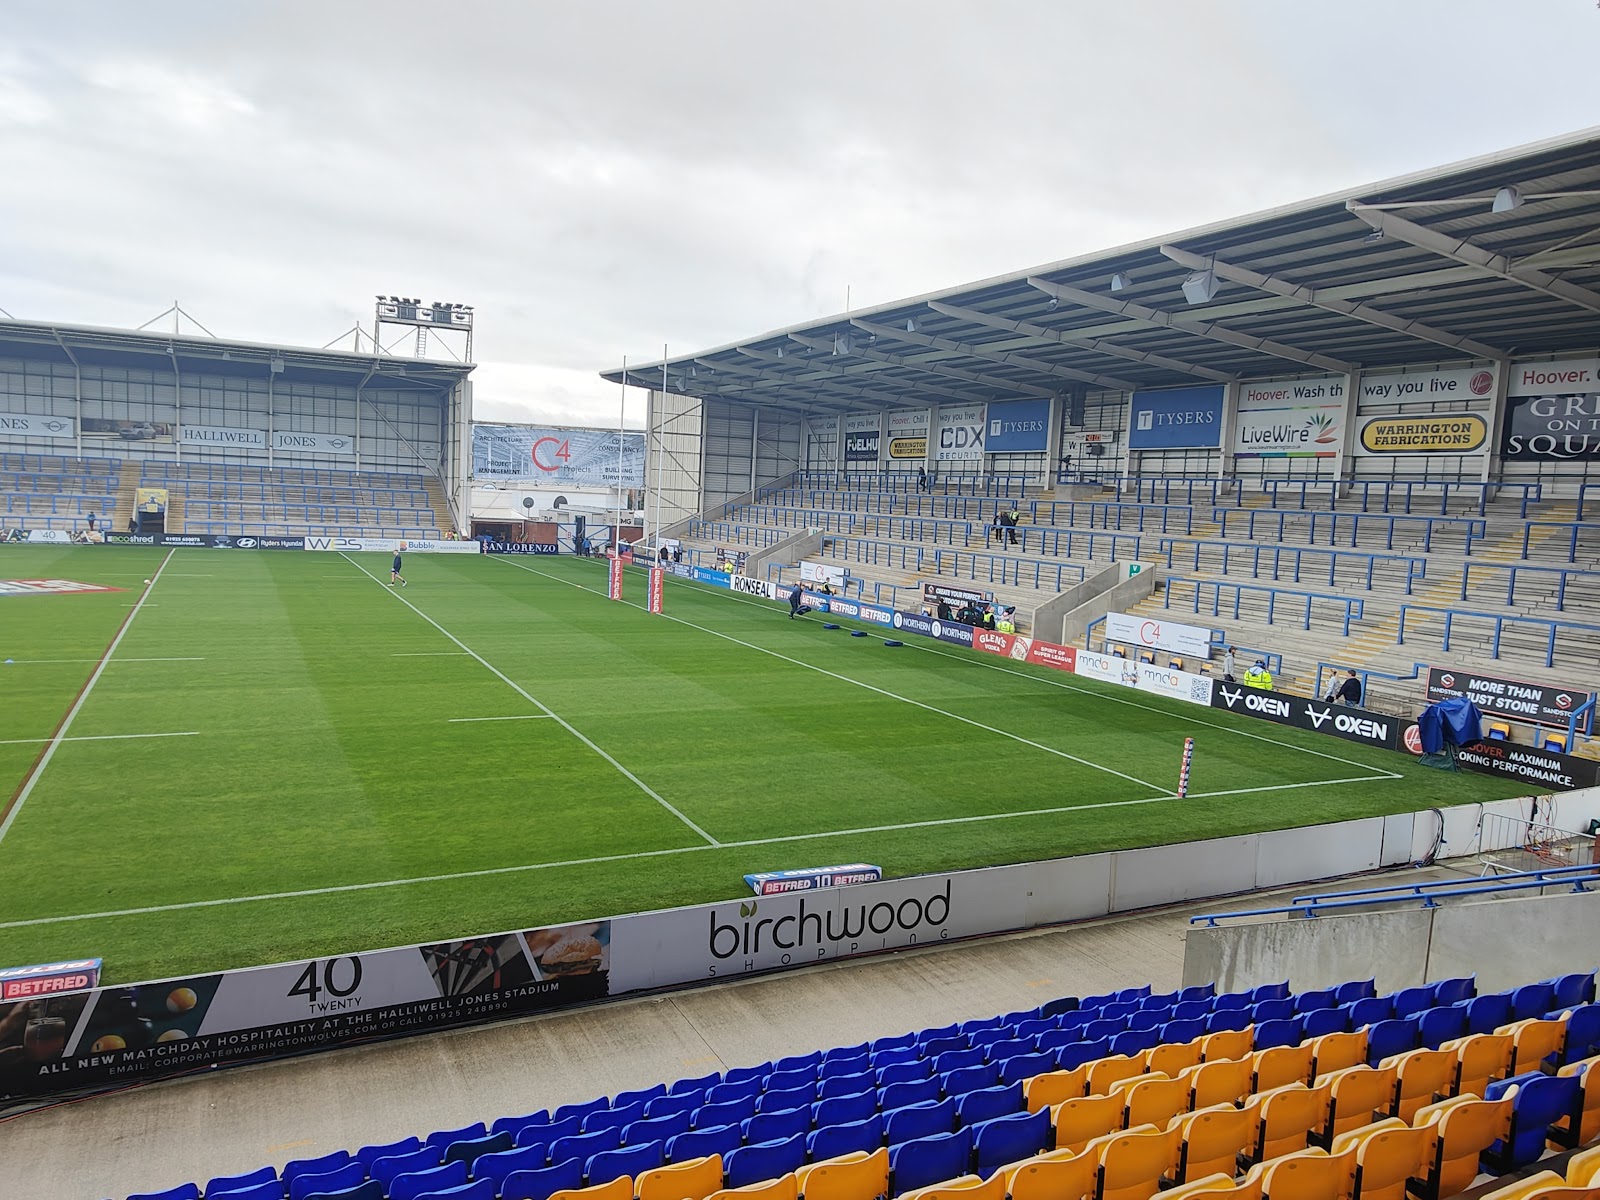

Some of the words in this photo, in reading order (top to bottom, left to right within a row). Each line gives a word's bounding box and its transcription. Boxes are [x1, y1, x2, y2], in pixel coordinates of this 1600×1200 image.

[1523, 370, 1591, 385] Hoover.
[1247, 389, 1290, 402] Hoover.
[1293, 385, 1325, 399] Wash
[1364, 383, 1392, 398] way
[1396, 383, 1424, 397] you
[1430, 378, 1458, 392] live
[952, 413, 963, 423] you
[964, 411, 976, 420] live
[1157, 410, 1214, 426] TYSERS
[1003, 420, 1043, 433] TYSERS
[1375, 422, 1473, 435] WARRINGTON
[1547, 419, 1581, 432] ON
[184, 429, 262, 444] HALLIWELL
[278, 435, 316, 447] JONES
[479, 435, 523, 443] ARCHITECTURE
[941, 426, 984, 449] CDX
[1241, 424, 1309, 444] LiveWire
[1374, 434, 1471, 446] FABRICATIONS
[531, 436, 571, 472] C4
[598, 445, 640, 453] CONSULANCY
[478, 467, 521, 475] MANAGEMENT
[563, 464, 592, 474] Projects
[42, 530, 56, 539] 40
[111, 535, 154, 544] ecoshred
[260, 539, 280, 548] Ryders
[281, 540, 304, 548] Hyundai
[507, 543, 556, 553] LORENZO
[653, 569, 661, 613] BETFRED
[734, 576, 771, 599] RONSEAL
[950, 590, 963, 599] YOUR
[830, 600, 858, 616] BETFRED
[860, 606, 891, 623] BETFRED
[902, 617, 931, 632] NORTHERN
[941, 626, 973, 642] NORTHERN
[979, 633, 1007, 649] GLEN'S
[1140, 621, 1161, 645] C4
[984, 643, 1001, 652] VODKA
[1040, 646, 1057, 655] SPIRIT
[1033, 650, 1051, 659] SUPER
[1051, 654, 1073, 664] LEAGUE
[1429, 686, 1464, 697] SANDSTONE
[1468, 678, 1506, 696] MORE
[1507, 684, 1543, 701] THAN
[1245, 694, 1290, 718] OXEN
[1495, 696, 1540, 715] STONE
[1334, 714, 1388, 741] OXEN
[1508, 751, 1562, 771] MAXIMUM
[1492, 758, 1576, 788] PERFORMANCE.
[765, 879, 811, 893] BETFRED
[815, 874, 831, 888] 10
[834, 873, 878, 886] BETFRED
[709, 878, 952, 960] birchwood
[708, 928, 949, 977] SHOPPING
[7, 975, 89, 997] BETFRED
[287, 955, 363, 1003] 40
[309, 996, 362, 1014] TWENTY
[38, 1062, 71, 1076] ALL
[78, 1054, 116, 1069] NEW
[122, 1038, 211, 1062] MATCHDAY
[217, 1021, 316, 1047] HOSPITALITY
[323, 1018, 341, 1029] AT
[347, 1011, 374, 1026] THE
[379, 999, 453, 1020] HALLIWELL
[458, 991, 500, 1007] JONES
[504, 982, 560, 1000] STADIUM
[109, 1062, 150, 1076] EMAIL:
[154, 1022, 378, 1069] CORPORATE@WARRINGTONWOLVES.COM
[381, 1020, 396, 1031] OR
[399, 1015, 424, 1028] CALL
[427, 1009, 462, 1023] 01925
[466, 1001, 509, 1016] 248890
